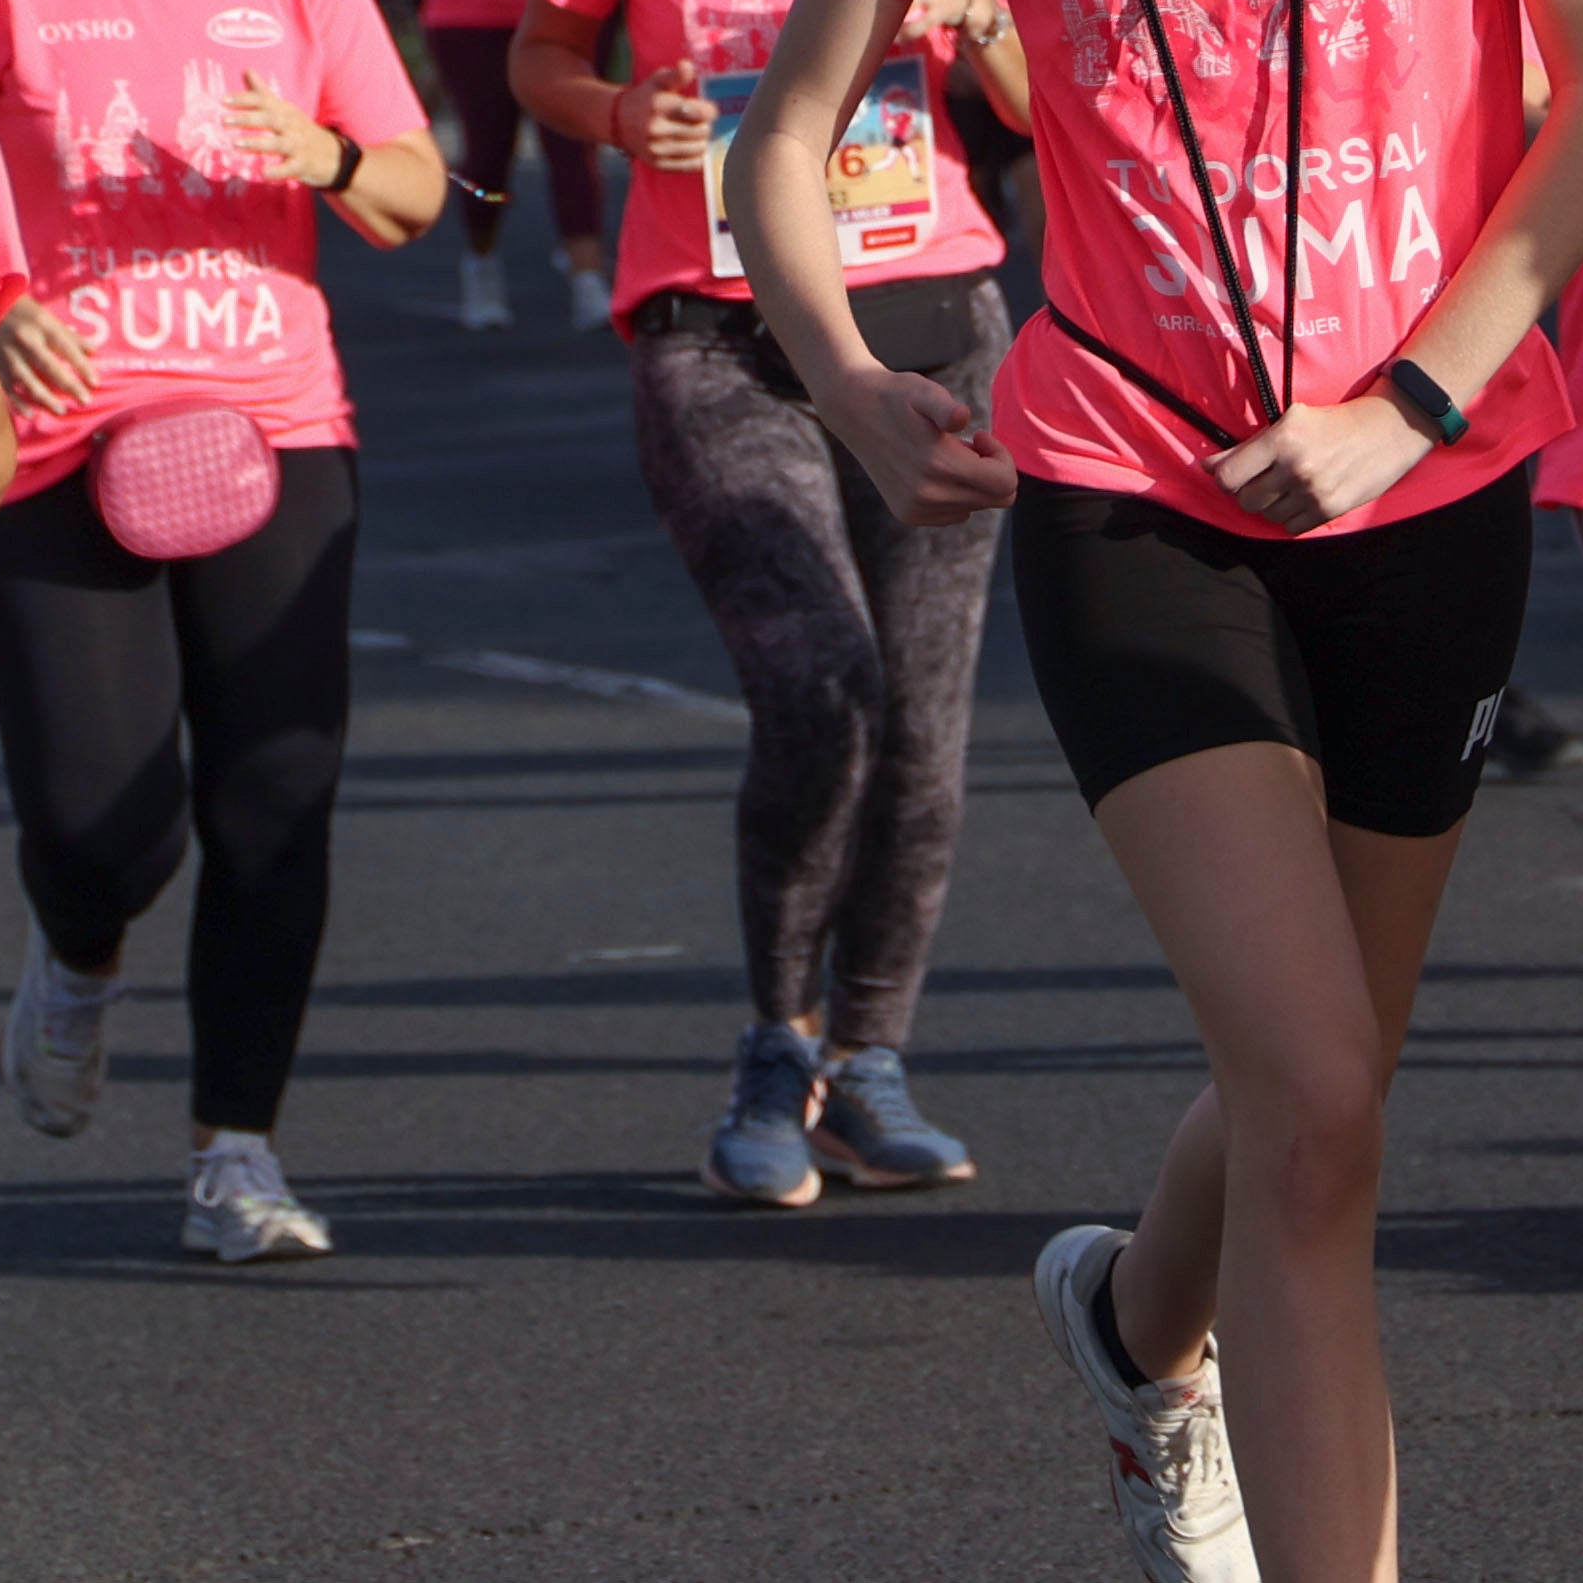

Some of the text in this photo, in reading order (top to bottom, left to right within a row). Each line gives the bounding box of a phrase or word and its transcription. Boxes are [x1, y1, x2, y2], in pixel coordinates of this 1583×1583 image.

[37, 19, 135, 45] OYSHO
[1106, 159, 1173, 204] TU
[67, 244, 278, 281] TU DORSAL
[1132, 185, 1442, 305] SUMA
[68, 284, 283, 350] SUMA
